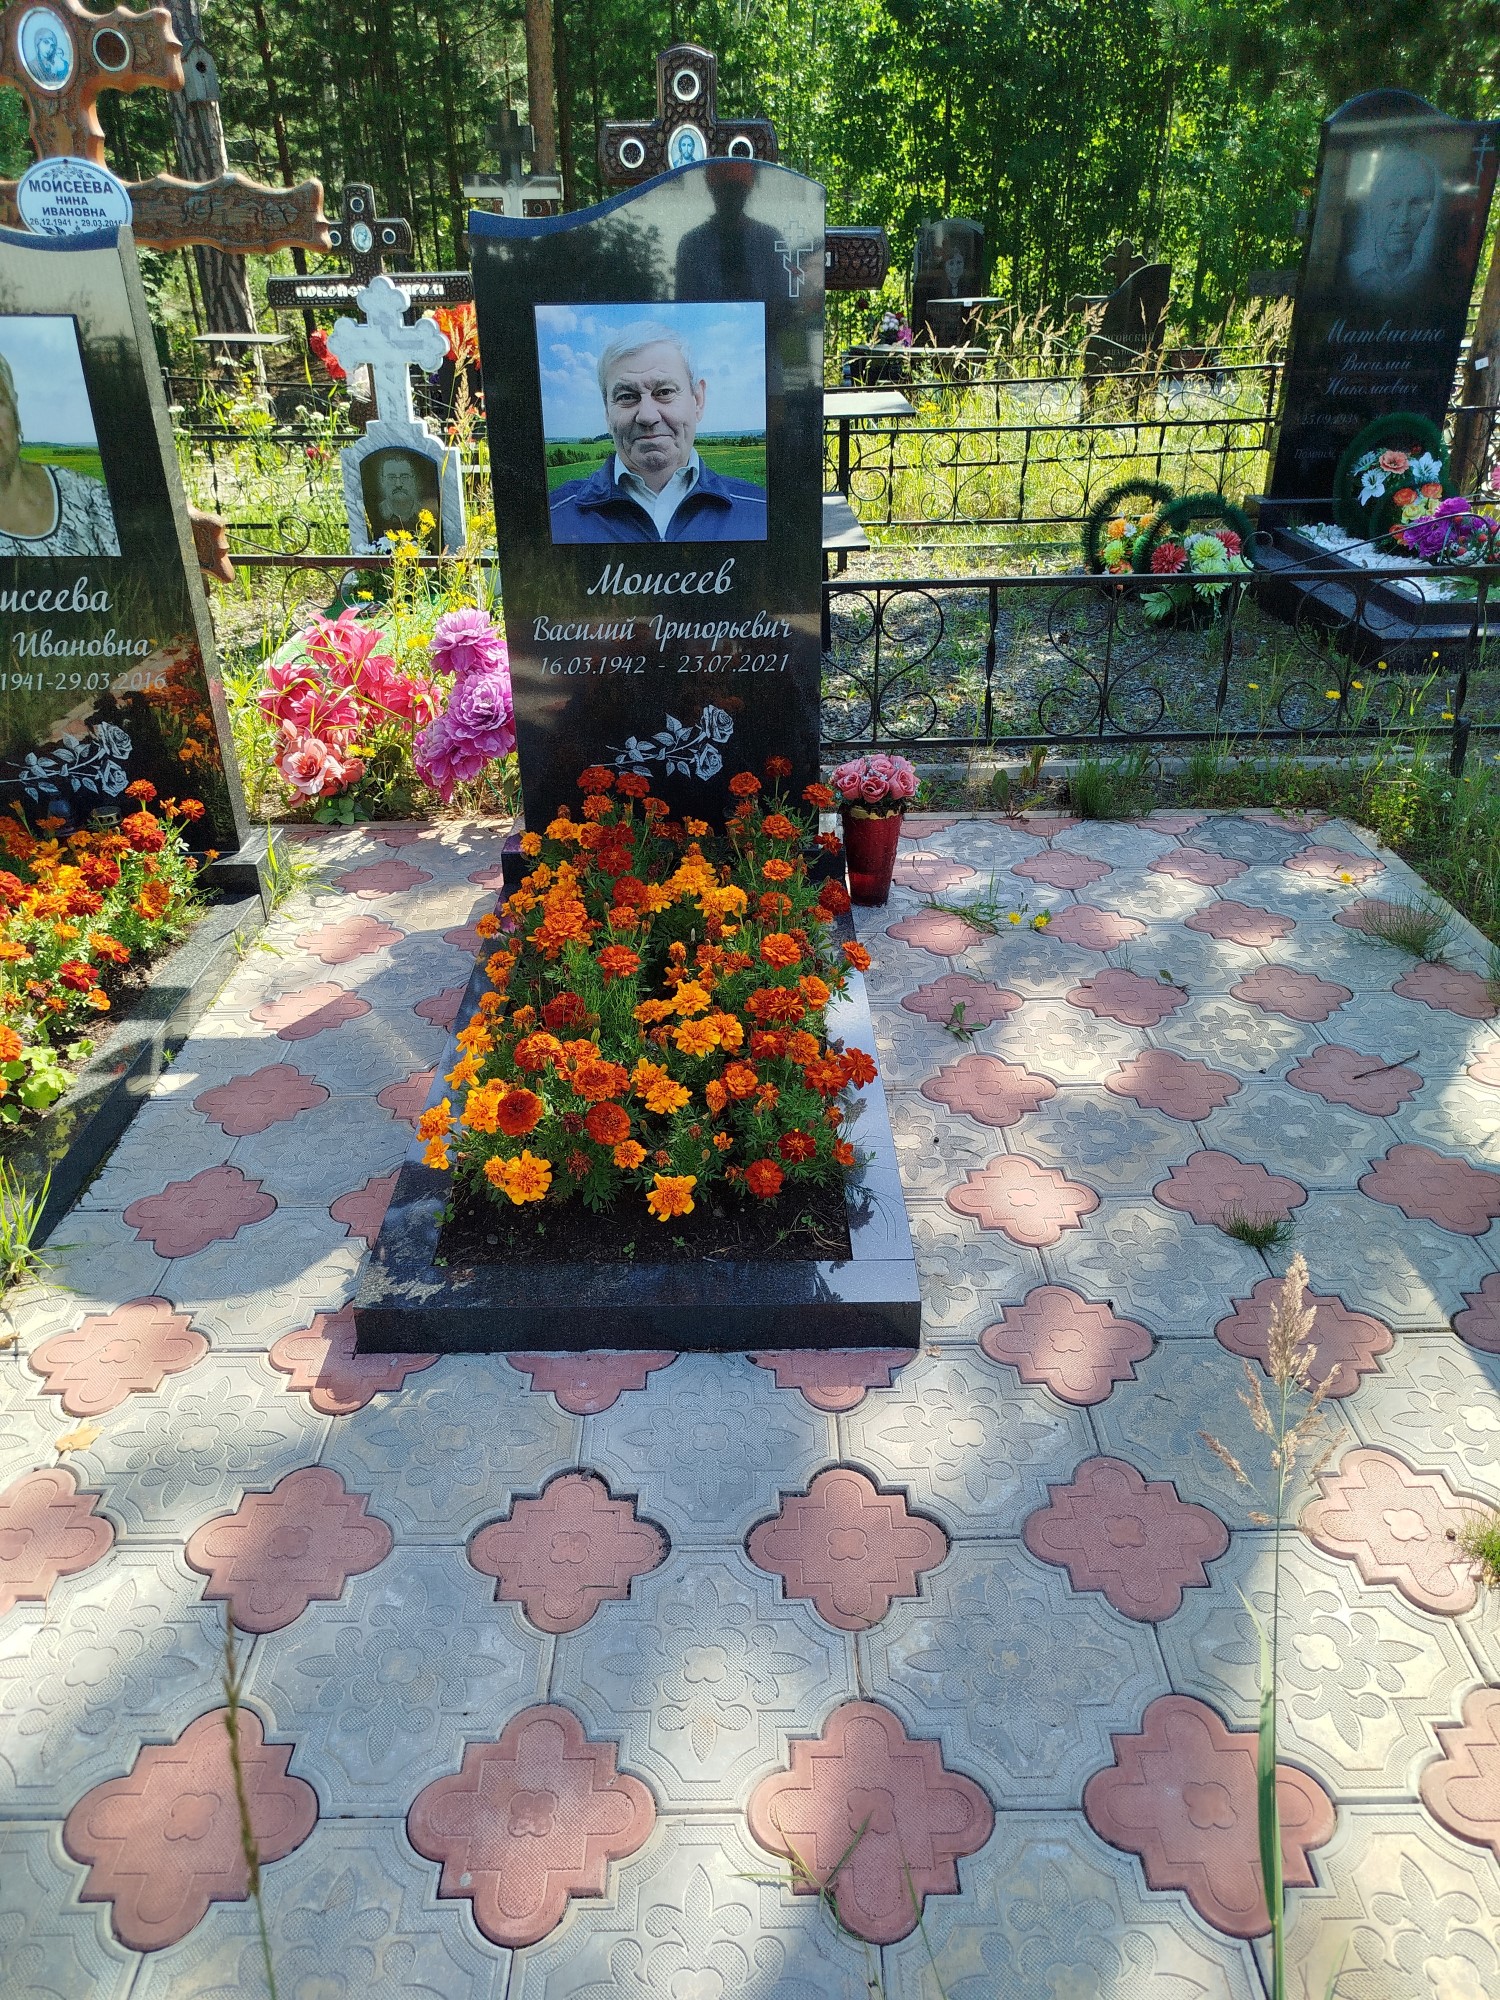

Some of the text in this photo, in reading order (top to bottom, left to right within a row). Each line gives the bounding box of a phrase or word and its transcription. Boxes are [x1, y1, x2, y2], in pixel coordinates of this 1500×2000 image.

[29, 180, 114, 194] МОИСЕЕВА
[56, 196, 89, 206] НИНА
[29, 218, 72, 227] 26.12.1941
[42, 207, 107, 218] ИВАНОВНА
[1317, 318, 1445, 344] Матвиенко
[1339, 352, 1413, 372] Василий
[1322, 376, 1420, 396] Николаевич
[586, 557, 736, 596] Моисеев
[532, 610, 793, 653] Василий Григорьевич
[12, 628, 153, 658] Ивановна
[540, 655, 647, 676] 16.03.1942
[677, 653, 790, 674] 23.07.2021
